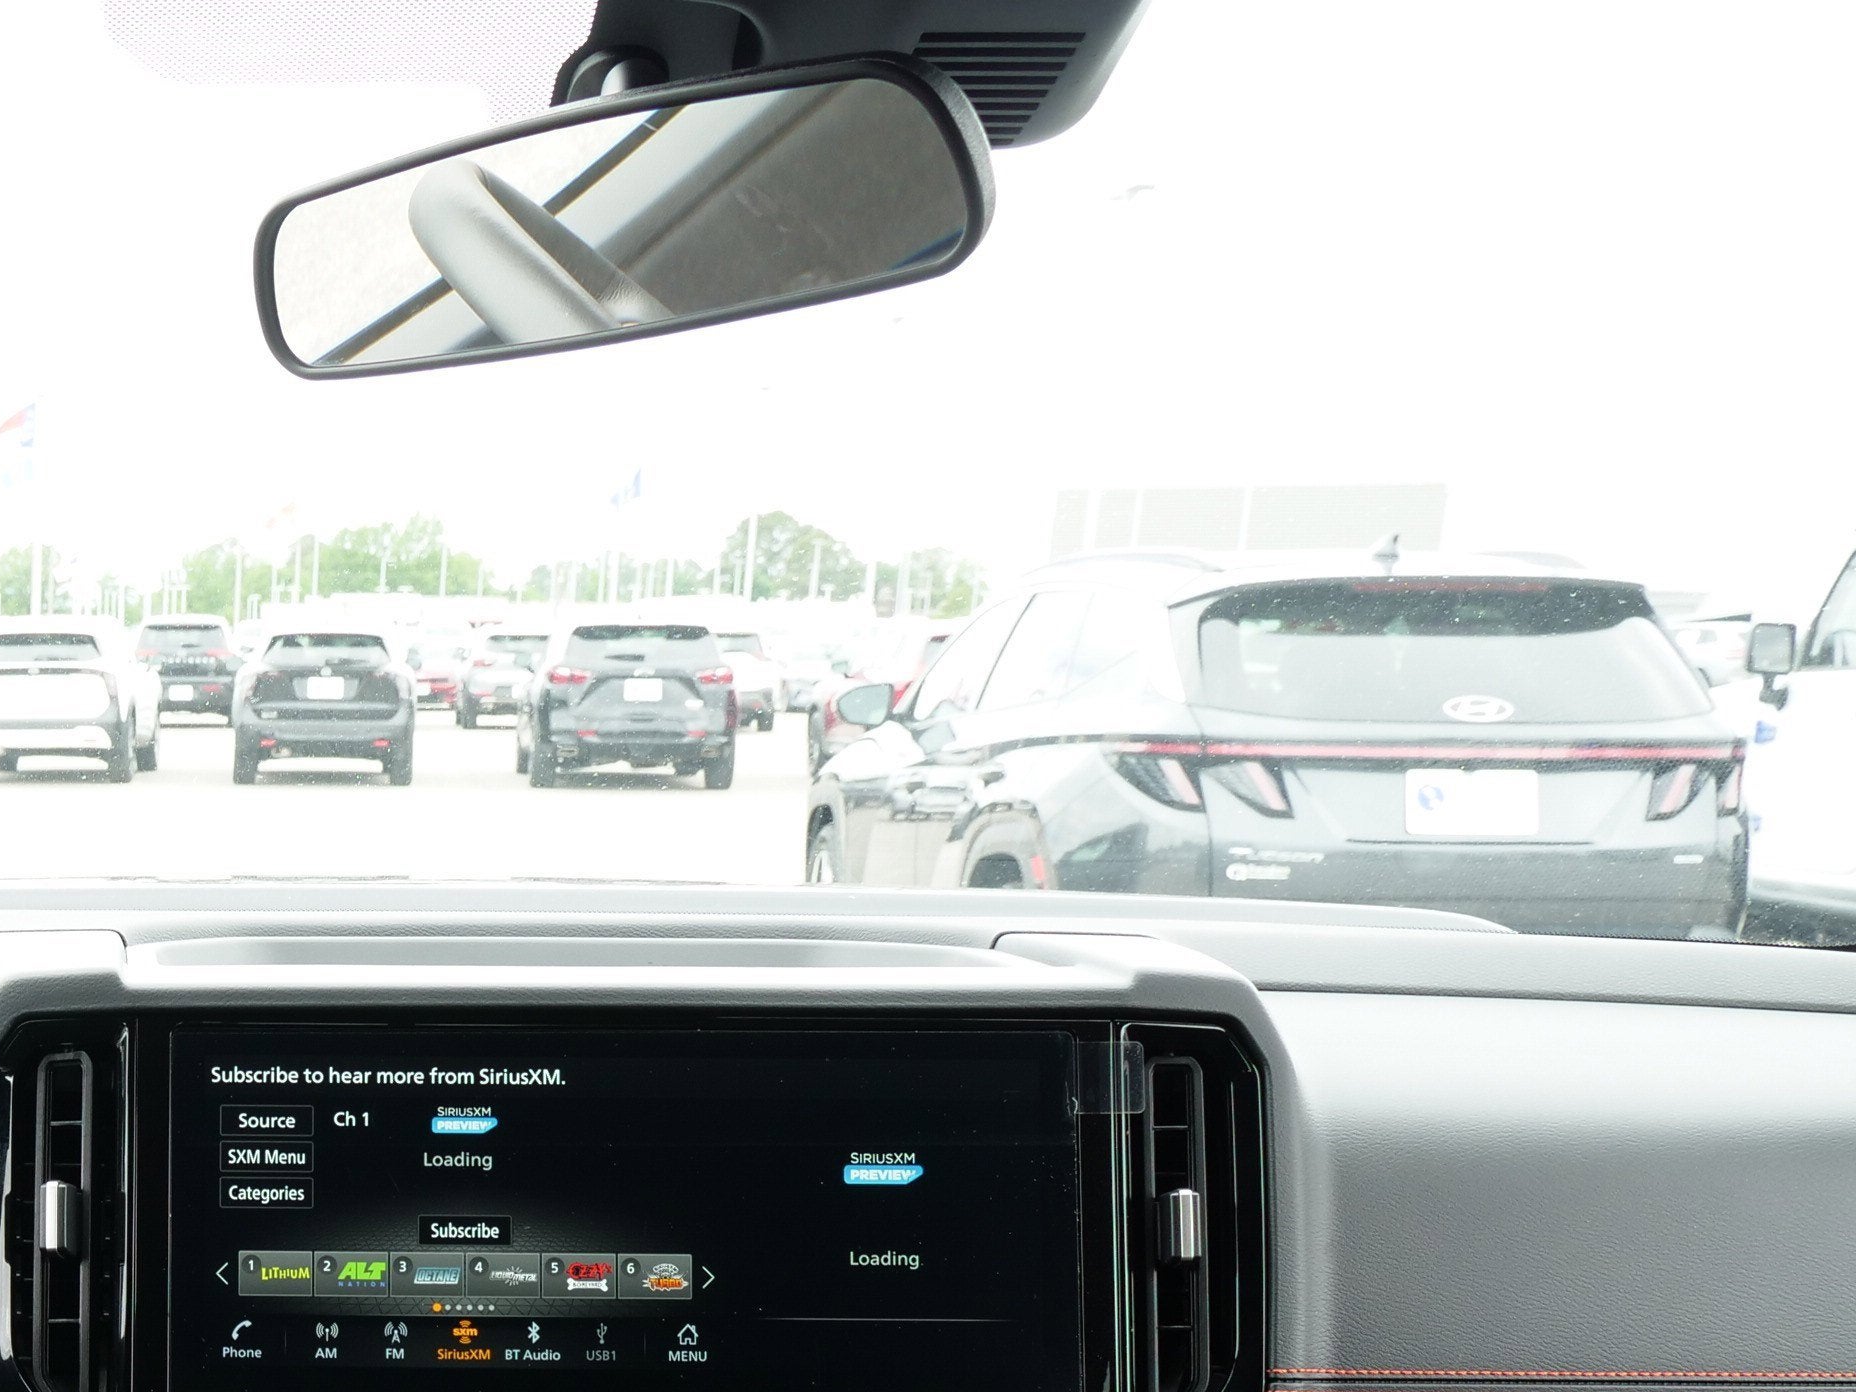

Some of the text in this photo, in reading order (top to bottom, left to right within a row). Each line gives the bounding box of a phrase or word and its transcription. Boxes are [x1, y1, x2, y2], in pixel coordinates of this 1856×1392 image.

[211, 1066, 566, 1085] Subscribe to hear more from SiriusXM.
[437, 1106, 492, 1117] SIRIUSXM
[238, 1113, 296, 1129] Source
[333, 1111, 369, 1127] Ch 1
[437, 1121, 492, 1130] PREVIEW
[228, 1149, 306, 1165] SXM Menu
[423, 1151, 493, 1171] Loading
[850, 1152, 916, 1164] SIRIUSXM
[851, 1169, 916, 1181] PREVIEW
[228, 1185, 305, 1204] Categories
[430, 1222, 500, 1239] Subscribe
[249, 1259, 254, 1271] 1
[850, 1250, 920, 1270] Loading
[323, 1261, 331, 1272] 2
[338, 1261, 386, 1280] ALT
[399, 1261, 407, 1272] 3
[475, 1262, 483, 1273] 4
[551, 1262, 558, 1273] 5
[626, 1263, 635, 1274] 6
[417, 1269, 458, 1283] OCTANE
[222, 1346, 262, 1359] Phone
[315, 1348, 337, 1359] AM
[386, 1348, 404, 1359] FM
[437, 1349, 491, 1360] SiriusXM
[505, 1349, 561, 1361] BT Audio
[586, 1350, 617, 1361] USB1
[668, 1350, 707, 1362] MENU
